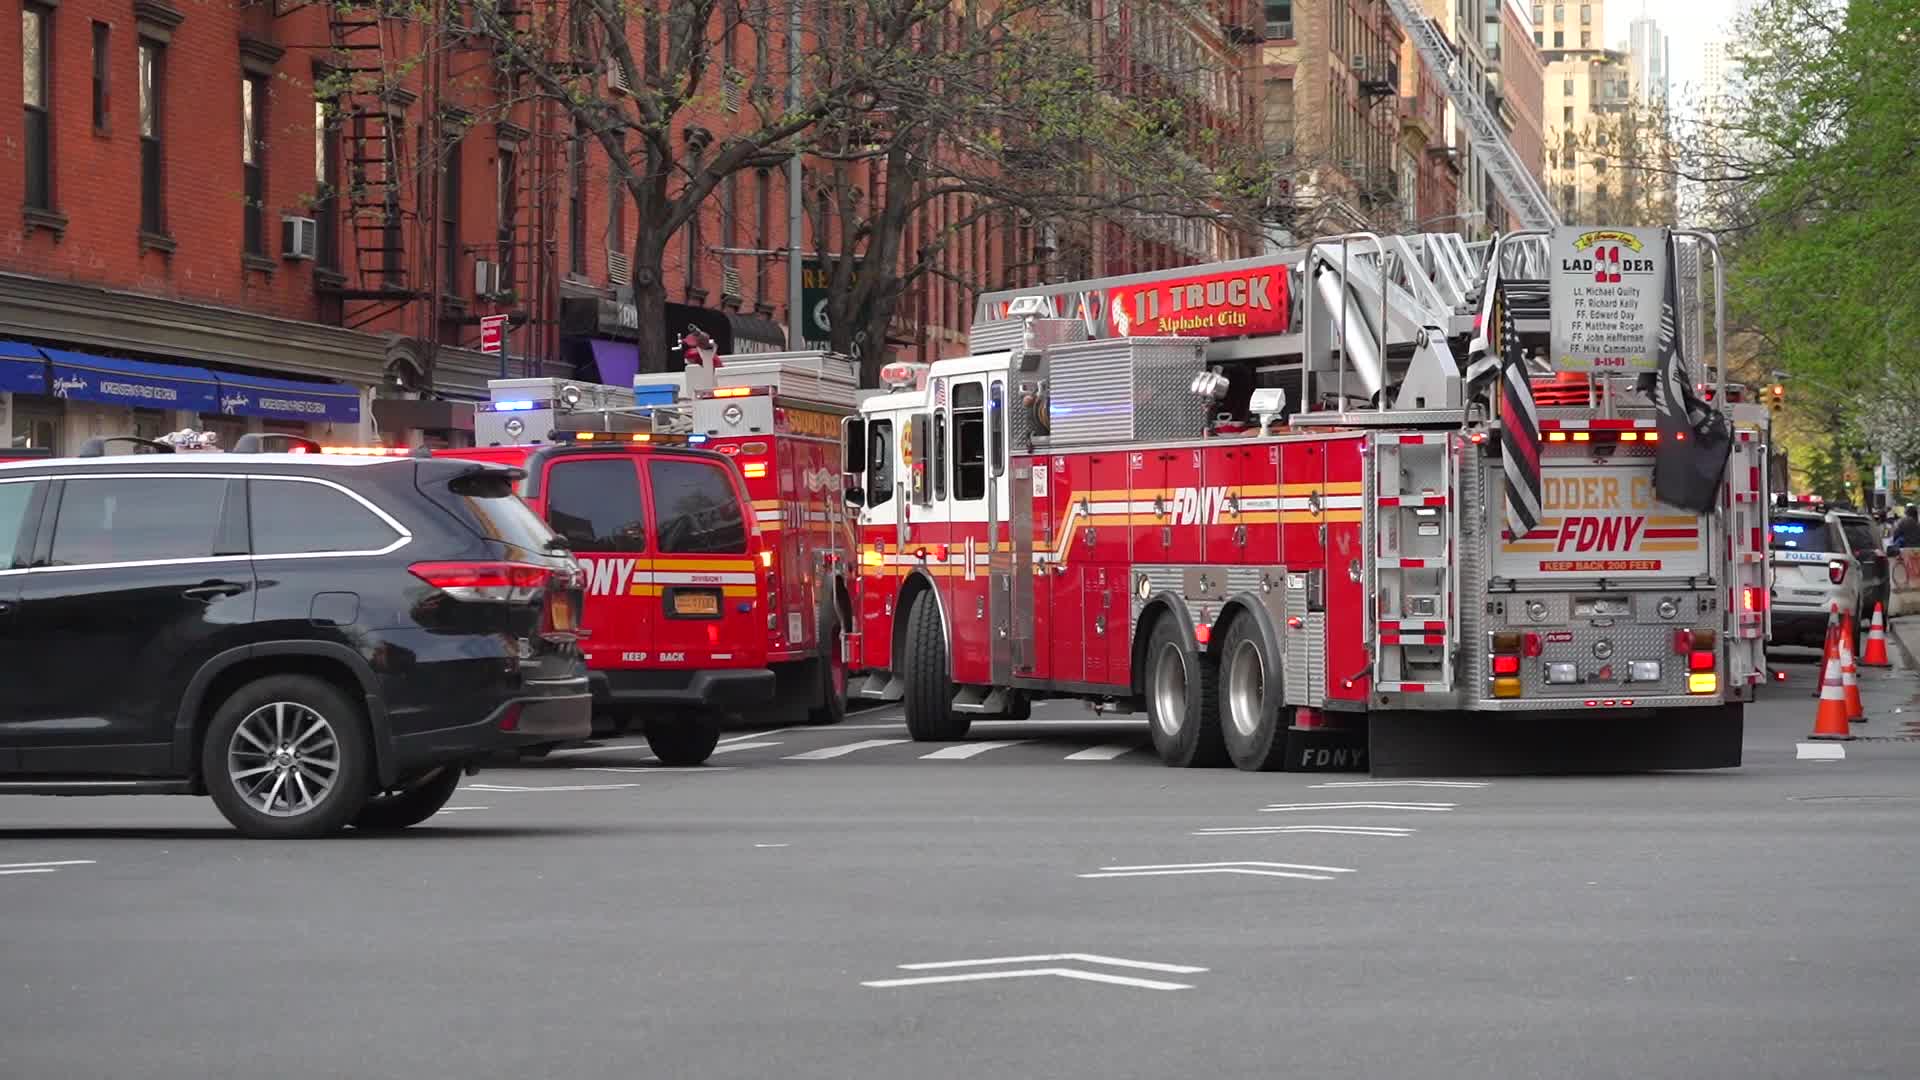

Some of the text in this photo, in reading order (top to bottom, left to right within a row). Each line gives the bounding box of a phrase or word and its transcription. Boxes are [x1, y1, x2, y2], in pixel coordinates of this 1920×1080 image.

[1563, 260, 1592, 271] LAD
[1623, 260, 1654, 271] DER
[1169, 275, 1272, 312] TRUCK
[1157, 312, 1248, 333] Alphabet City
[1621, 310, 1635, 321] Day
[1170, 486, 1229, 525] FDNY
[1557, 516, 1644, 552] FDNY
[1544, 560, 1656, 571] KEEP BACK 200 FEET
[1785, 551, 1824, 561] POLICE
[577, 558, 636, 596] DNY
[622, 652, 685, 662] KEEP BACK
[1302, 748, 1362, 767] FDNY
